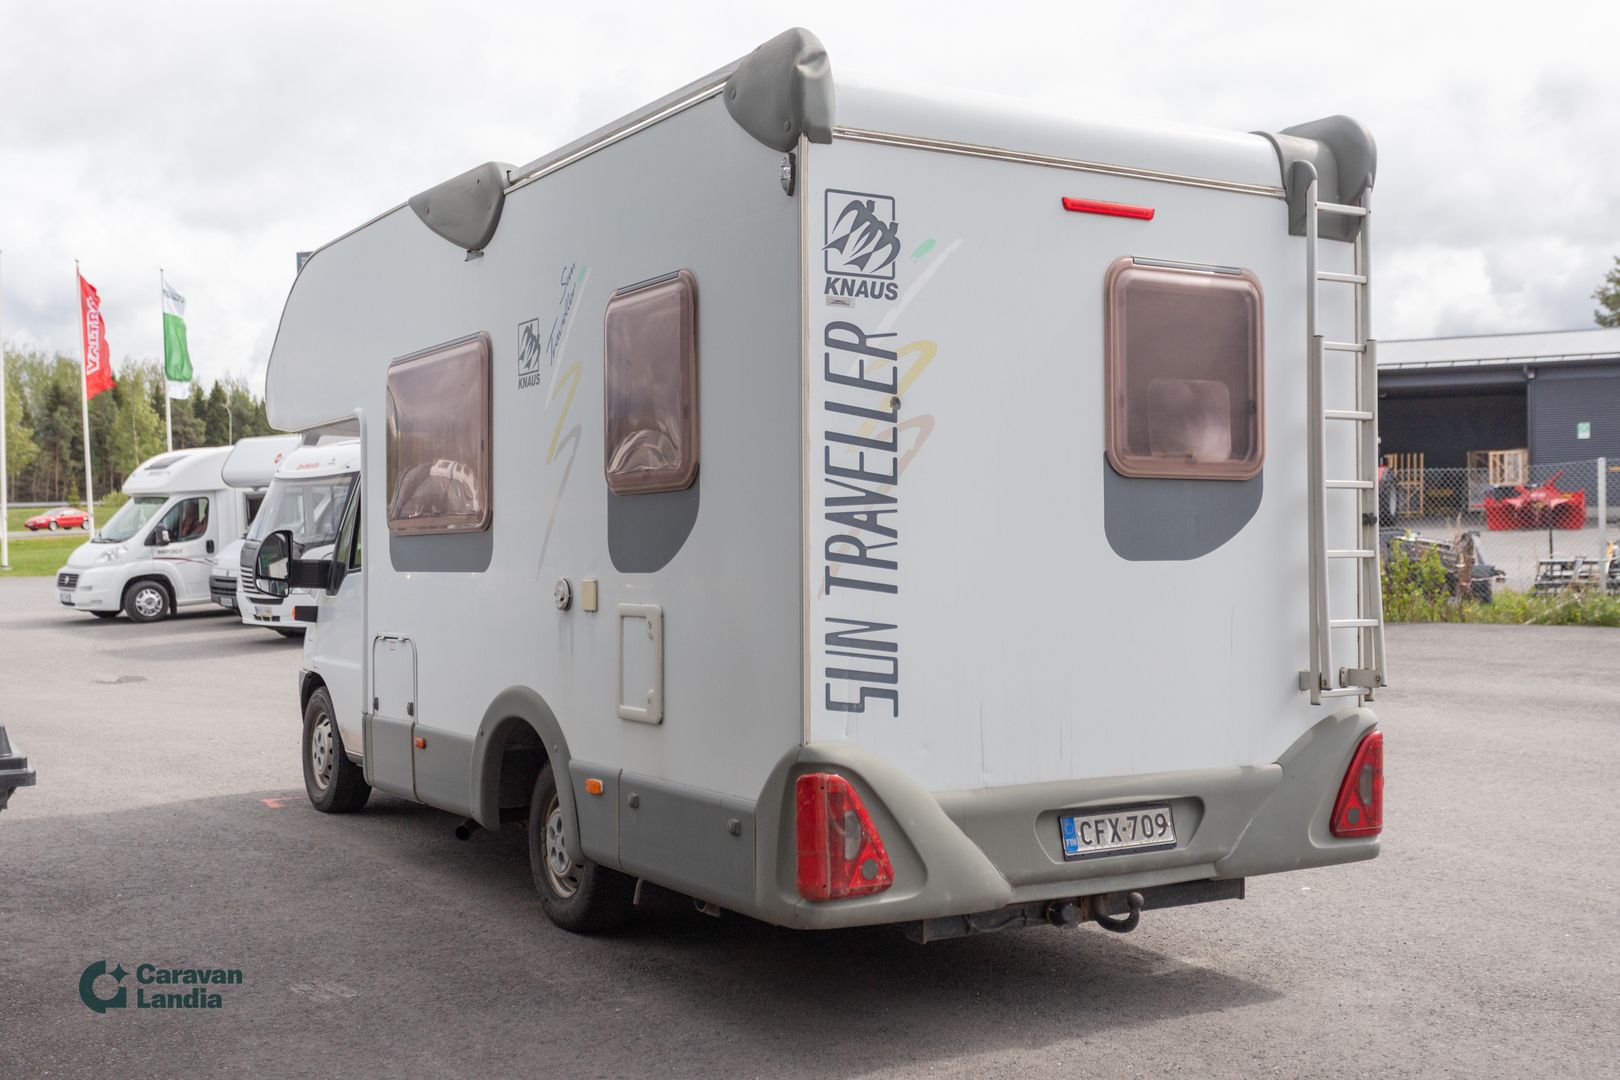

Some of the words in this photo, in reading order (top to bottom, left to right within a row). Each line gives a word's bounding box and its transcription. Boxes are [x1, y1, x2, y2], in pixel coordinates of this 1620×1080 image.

[823, 277, 899, 301] KNAUS
[517, 373, 541, 390] KNAUS
[824, 320, 899, 595] TRAVELLER
[824, 617, 899, 719] SUN
[1079, 813, 1169, 845] CFX-709
